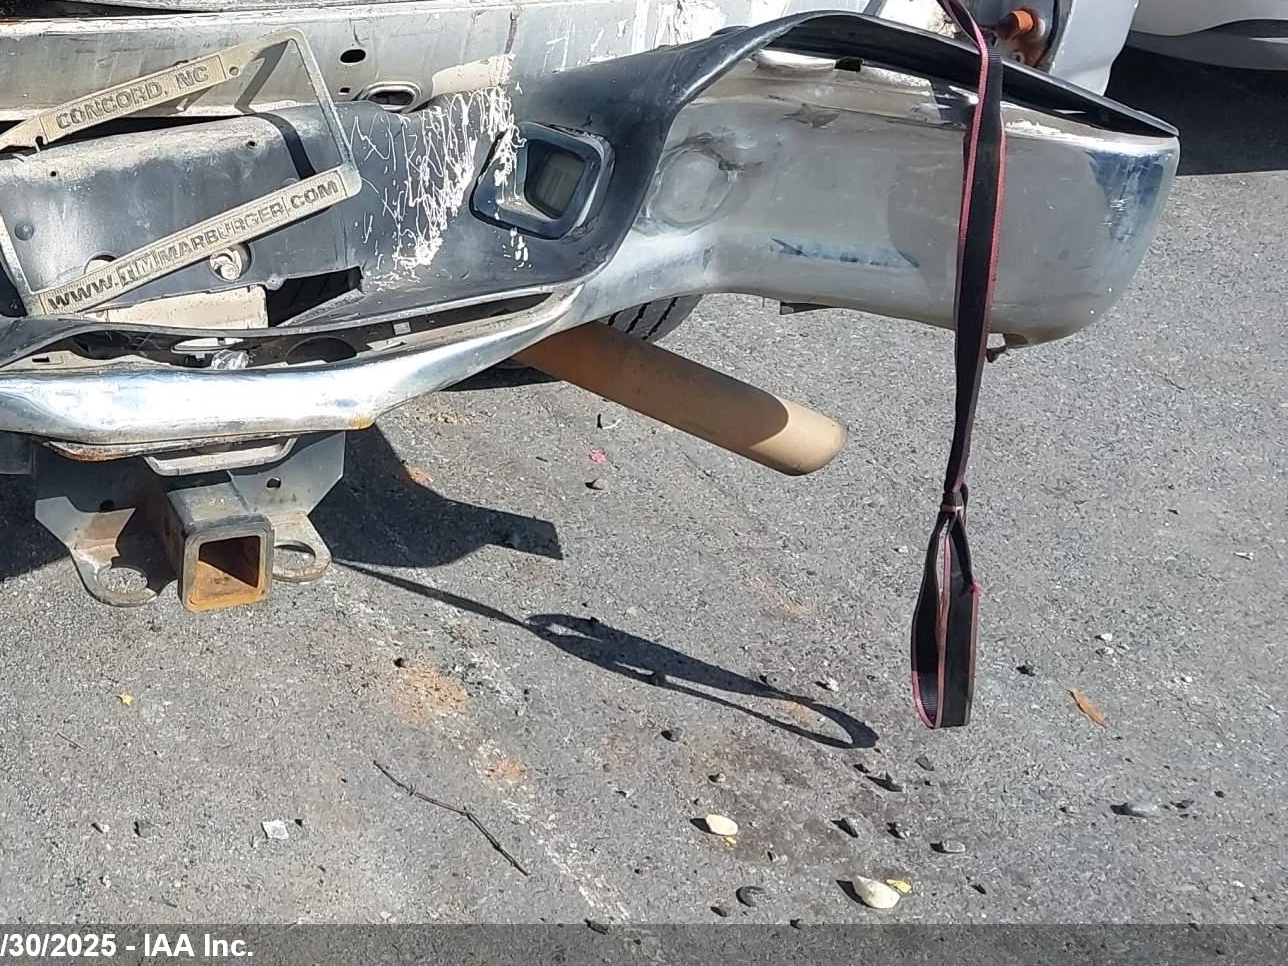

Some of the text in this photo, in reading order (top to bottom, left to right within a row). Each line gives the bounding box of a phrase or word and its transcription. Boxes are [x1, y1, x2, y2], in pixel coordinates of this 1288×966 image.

[55, 65, 210, 130] CONCORD, NC
[47, 180, 340, 311] WWW.TIMMARBURGER.COM
